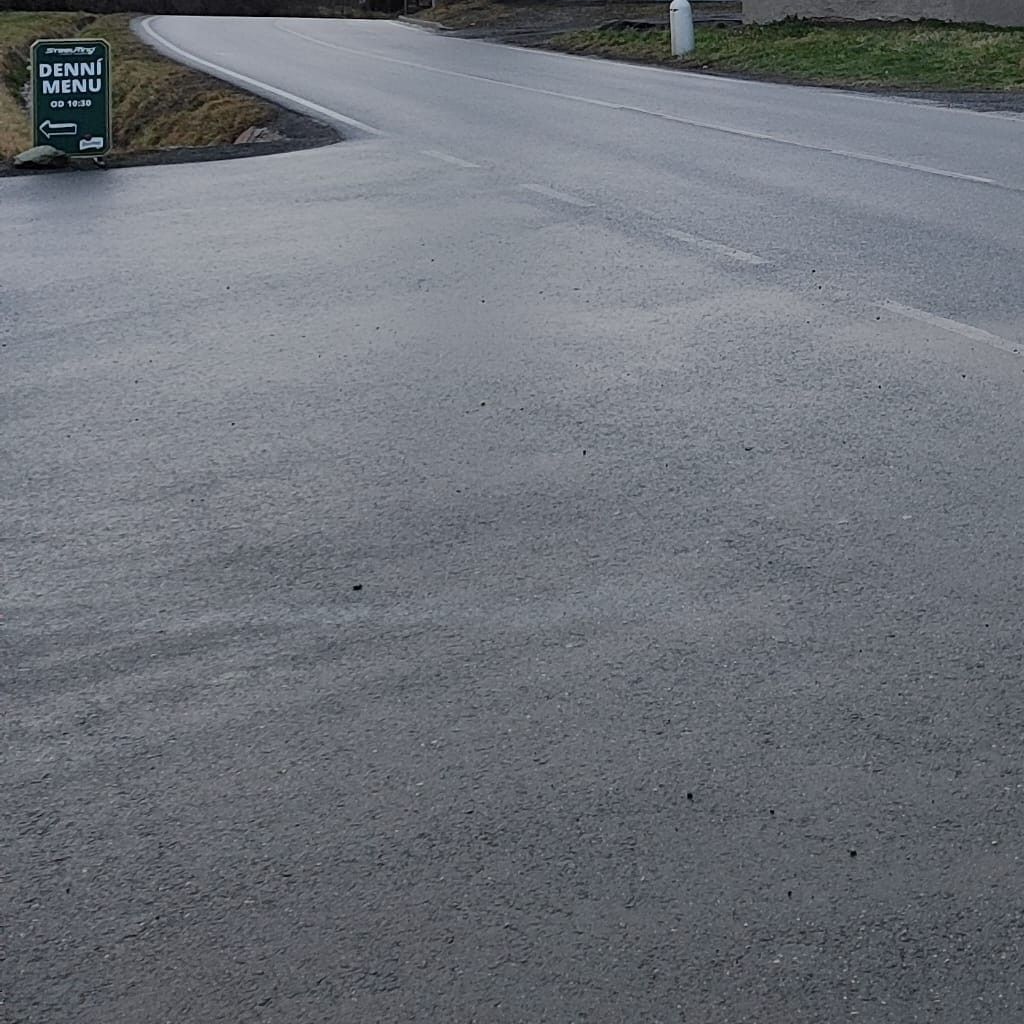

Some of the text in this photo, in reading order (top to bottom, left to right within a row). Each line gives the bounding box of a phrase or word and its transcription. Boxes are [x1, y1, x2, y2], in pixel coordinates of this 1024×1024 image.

[39, 57, 104, 78] DENNÍ
[42, 78, 102, 94] MENU
[50, 99, 92, 108] OD 10:30
